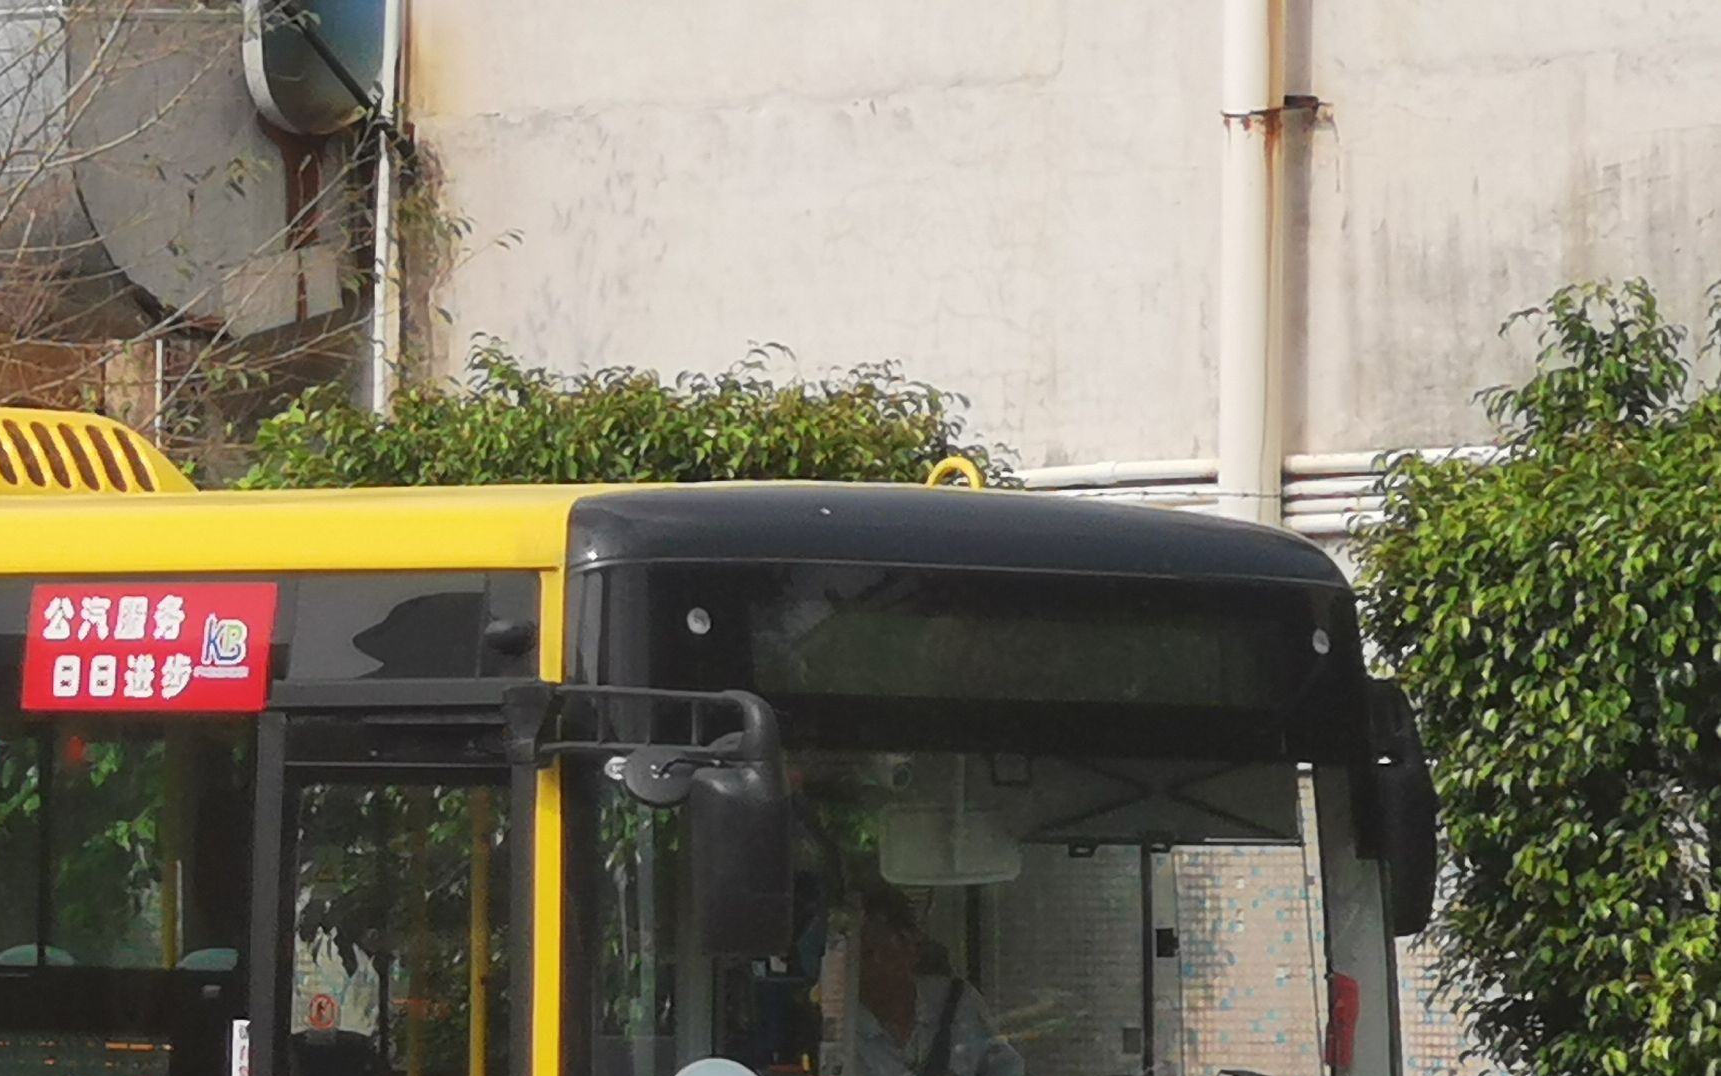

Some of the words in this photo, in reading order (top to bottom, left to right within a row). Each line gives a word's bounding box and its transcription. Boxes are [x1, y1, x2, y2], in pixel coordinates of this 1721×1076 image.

[43, 595, 186, 640] 公汽服务
[53, 653, 193, 699] 日日进步
